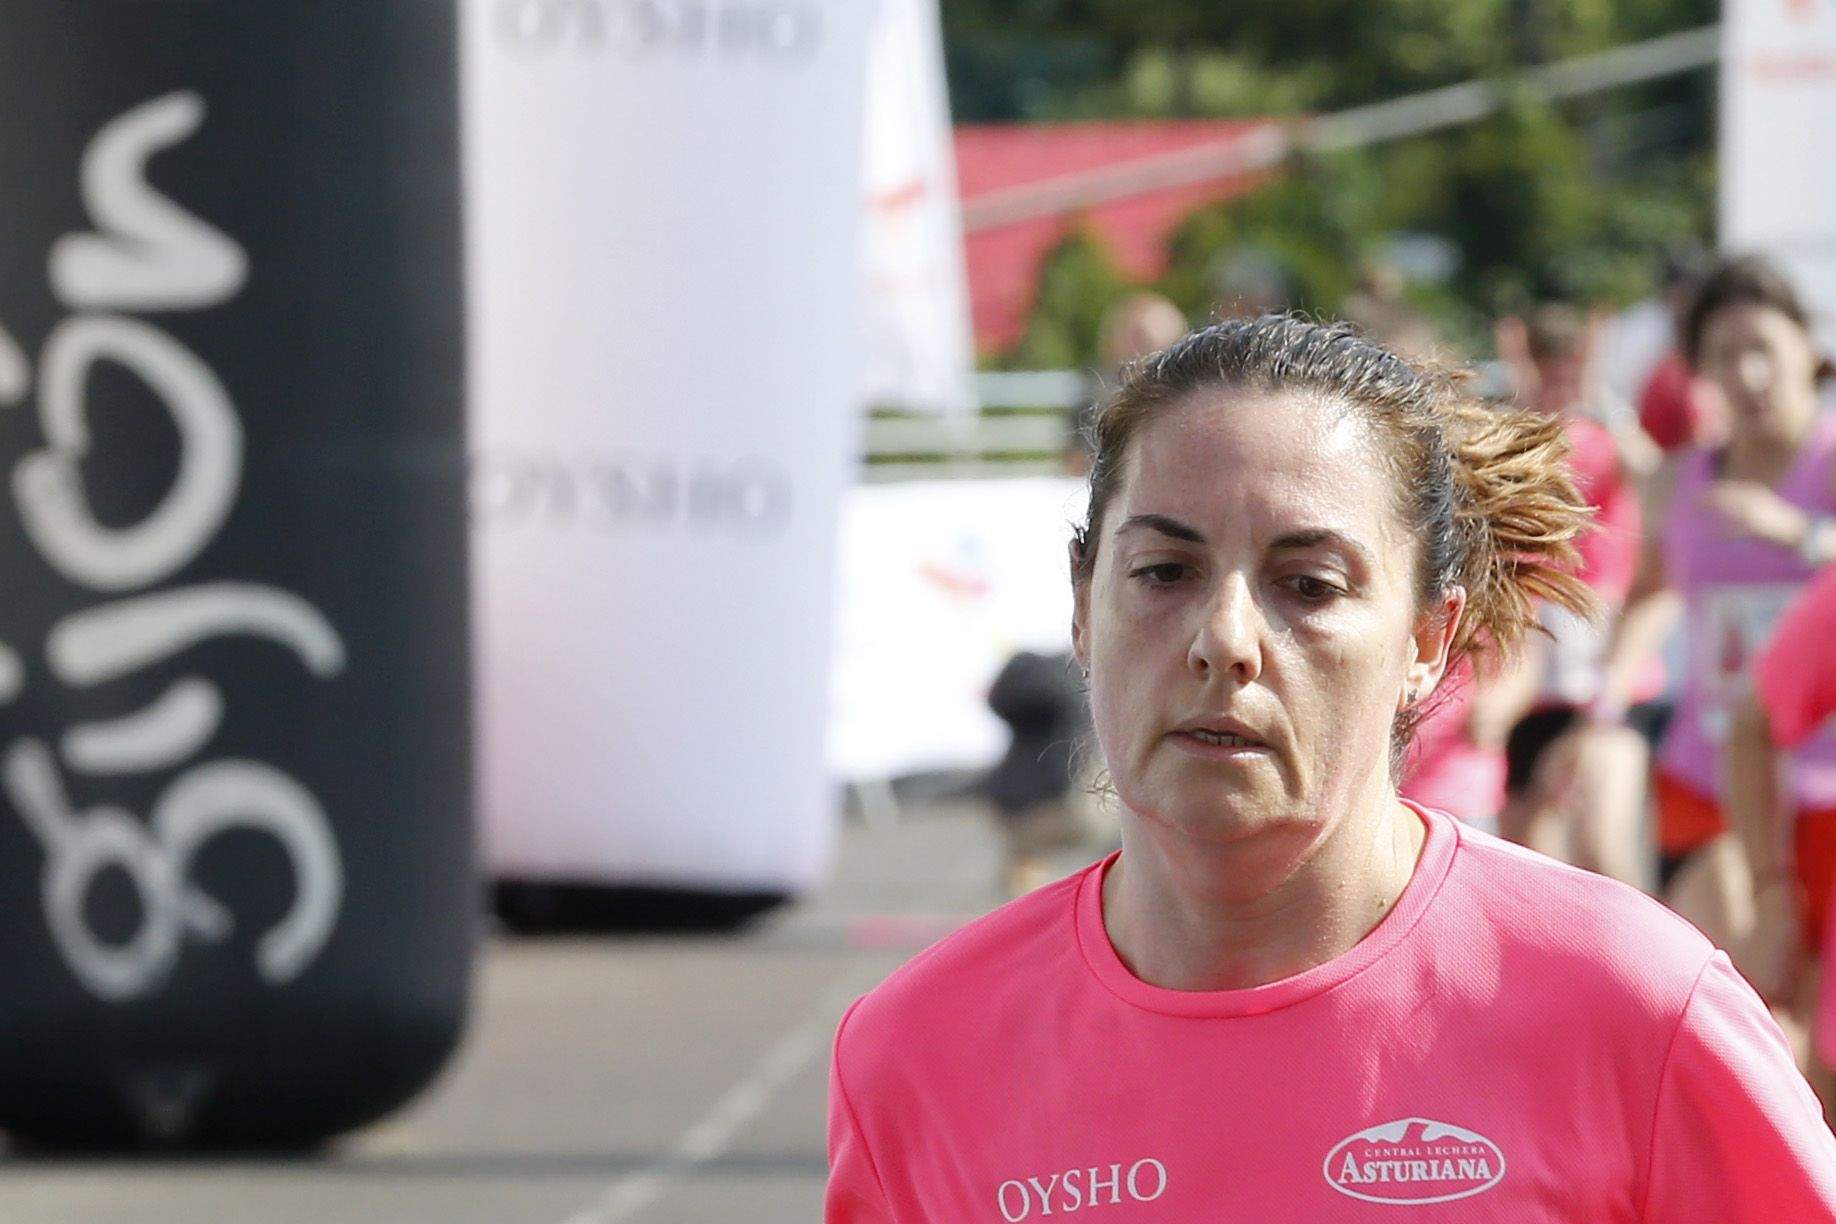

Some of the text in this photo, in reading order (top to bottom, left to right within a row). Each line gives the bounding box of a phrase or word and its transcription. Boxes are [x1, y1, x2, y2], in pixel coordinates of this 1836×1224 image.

[1337, 1150, 1494, 1185] ASTURIANA
[1363, 1145, 1487, 1158] CENTRAL LECHERA
[997, 1156, 1168, 1224] OYSHO
